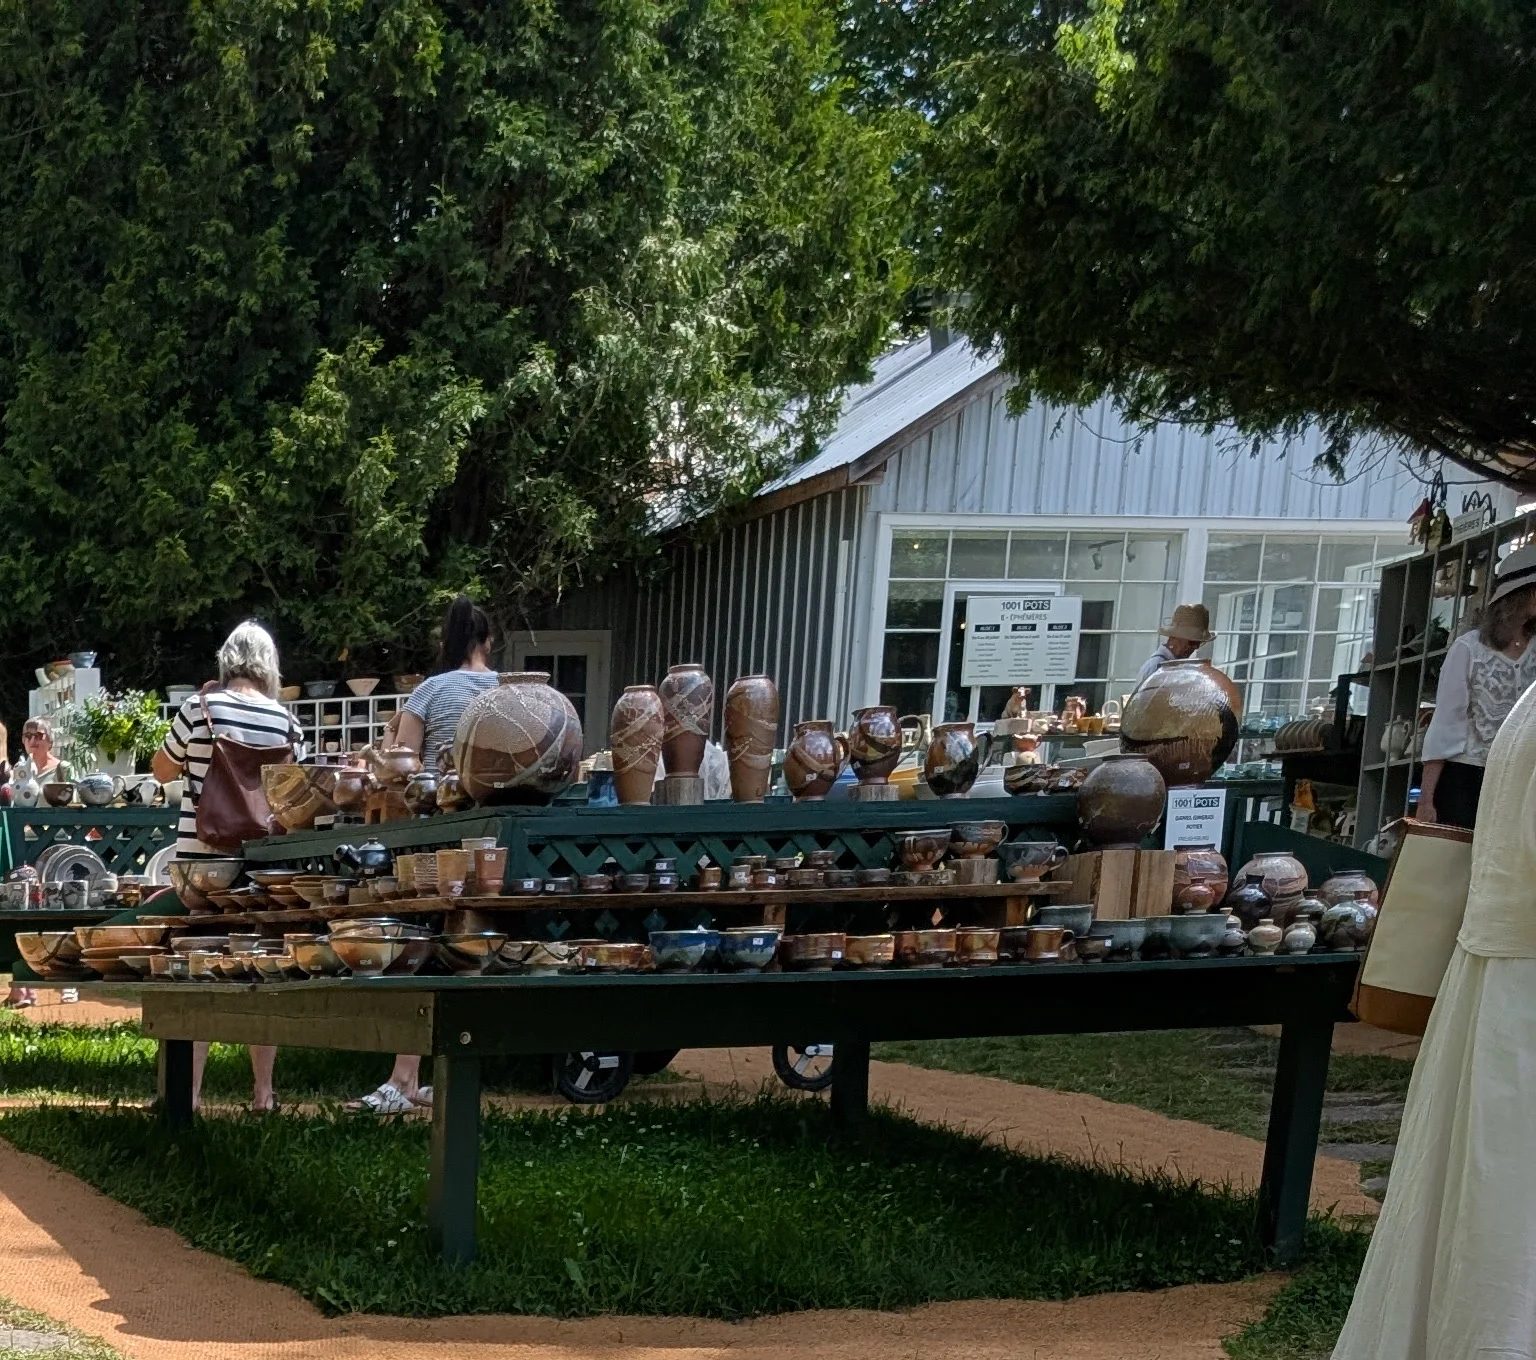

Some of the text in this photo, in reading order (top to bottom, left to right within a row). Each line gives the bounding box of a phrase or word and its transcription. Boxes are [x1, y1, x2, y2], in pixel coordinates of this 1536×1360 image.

[1001, 600, 1050, 610] 1001 POTS
[1174, 798, 1219, 808] 1001 POTS
